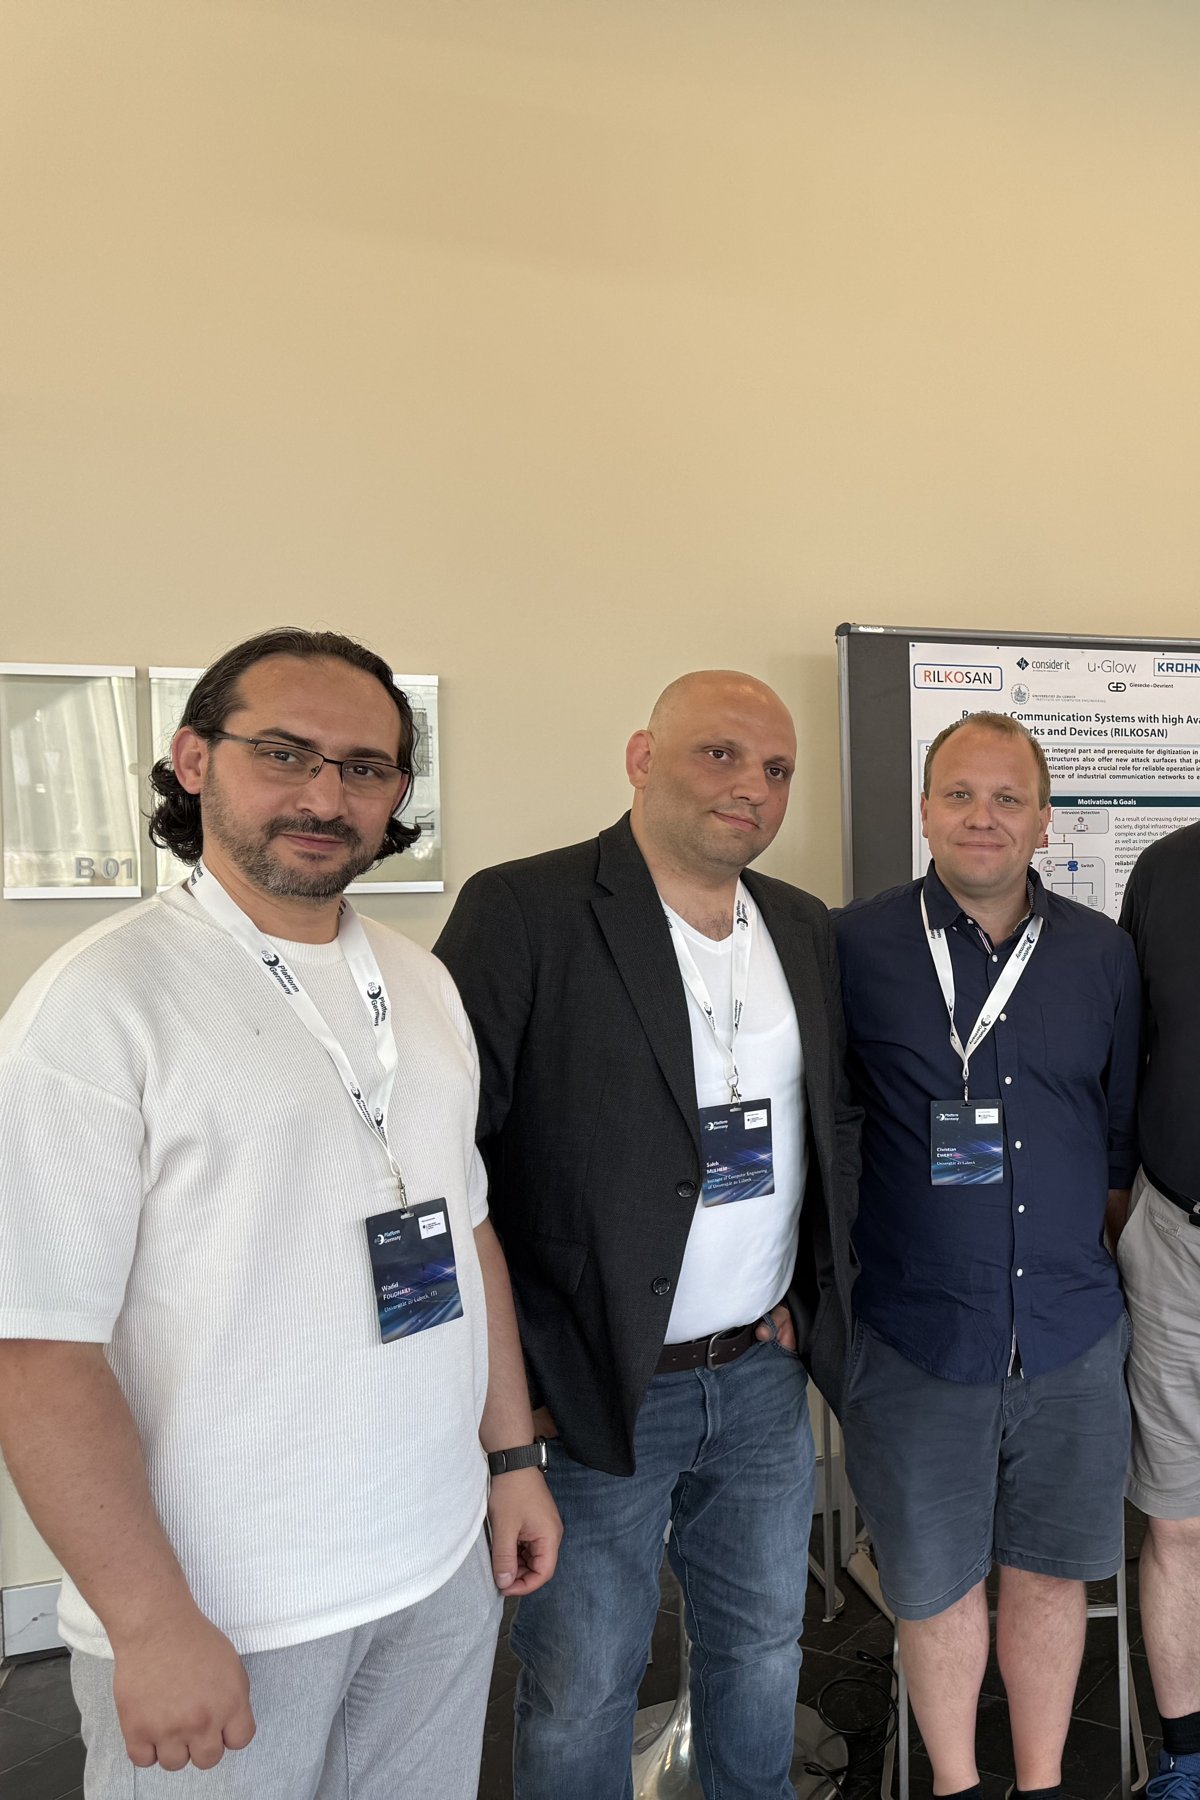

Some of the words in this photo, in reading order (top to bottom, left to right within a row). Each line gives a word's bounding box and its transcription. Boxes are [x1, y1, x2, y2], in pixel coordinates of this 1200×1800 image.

[1032, 660, 1062, 670] consider
[1065, 660, 1070, 670] it
[924, 670, 992, 684] RILKOSAN
[1010, 711, 1092, 722] Communication
[1094, 714, 1135, 724] Systems
[1138, 714, 1159, 723] with
[1162, 714, 1184, 726] high
[1048, 727, 1066, 736] and
[1070, 727, 1108, 737] Devices
[1111, 728, 1168, 738] (RILKOSAN)
[75, 858, 95, 879] B
[103, 857, 132, 880] 01
[269, 966, 293, 995] Germany
[278, 964, 299, 993] Platform
[368, 982, 377, 991] 6G
[379, 996, 387, 1021] Platform
[384, 1235, 401, 1243] Germany
